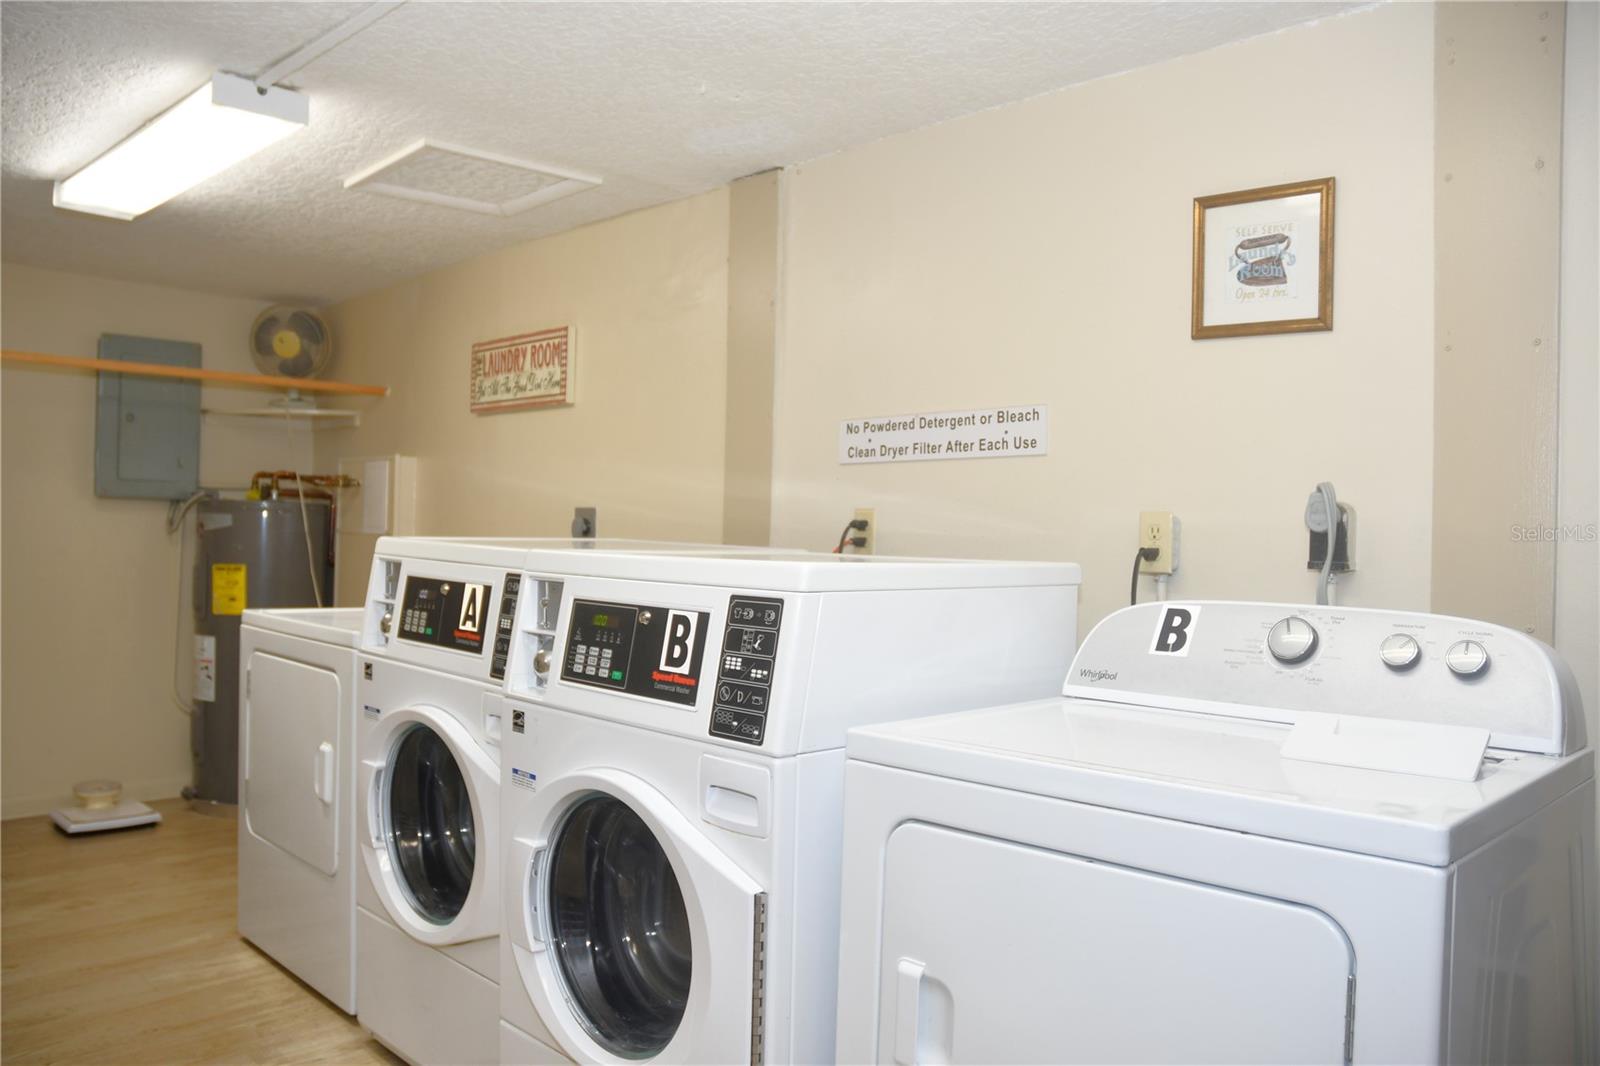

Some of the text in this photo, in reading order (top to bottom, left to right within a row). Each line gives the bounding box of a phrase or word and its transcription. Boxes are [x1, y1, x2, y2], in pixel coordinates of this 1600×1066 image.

[1235, 222, 1293, 237] SELF SERVE
[1235, 287, 1255, 304] Open
[1259, 287, 1271, 298] 24
[482, 347, 527, 377] LAUNDRY
[530, 341, 560, 369] ROOM
[846, 408, 1040, 434] No Powdered Detergent or Bleach
[847, 436, 1038, 459] Clean Dryer Filter After Each Use
[460, 587, 477, 628] A
[664, 614, 692, 668] B
[1154, 607, 1192, 652] B
[1080, 668, 1118, 682] Whirlpool
